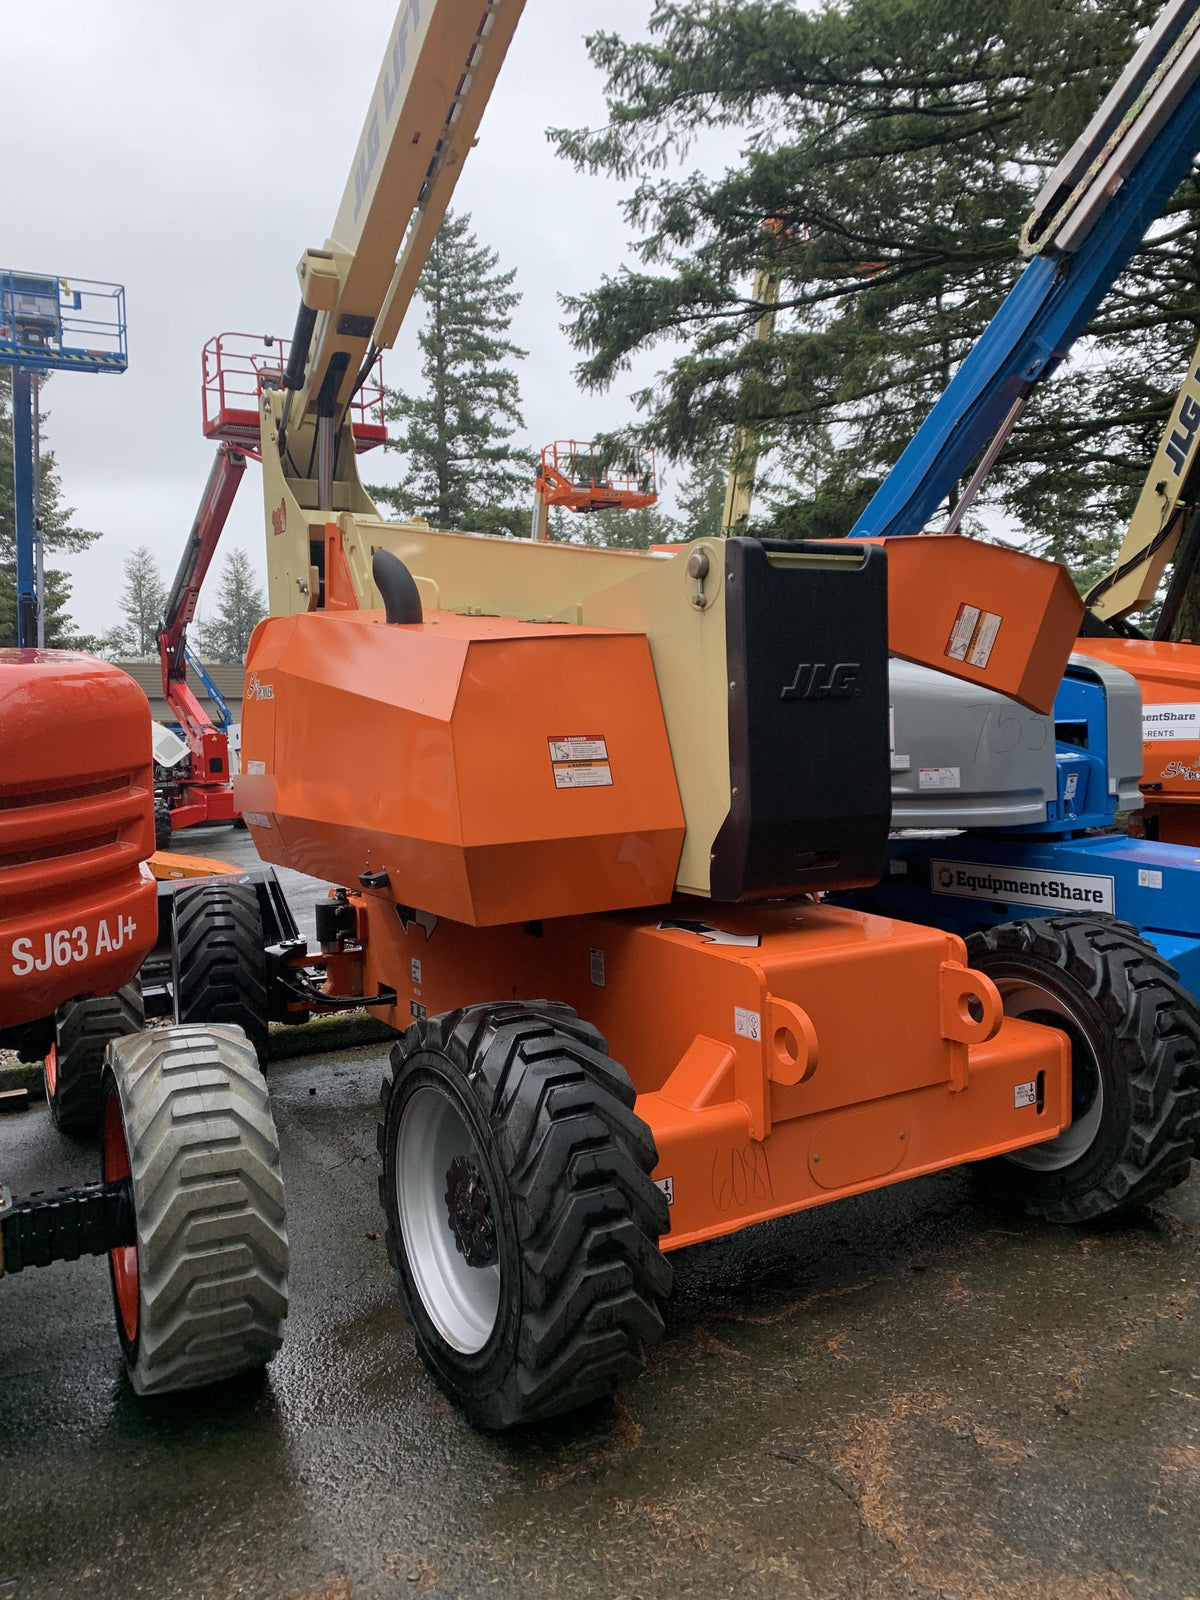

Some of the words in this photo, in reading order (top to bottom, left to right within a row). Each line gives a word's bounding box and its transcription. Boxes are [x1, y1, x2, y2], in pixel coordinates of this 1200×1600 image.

[354, 108, 380, 224] JLG
[1165, 393, 1200, 477] JLG
[779, 662, 861, 698] JLG
[956, 870, 1104, 904] EquipmentShare
[11, 926, 89, 976] SJ63
[95, 914, 137, 956] AJ+
